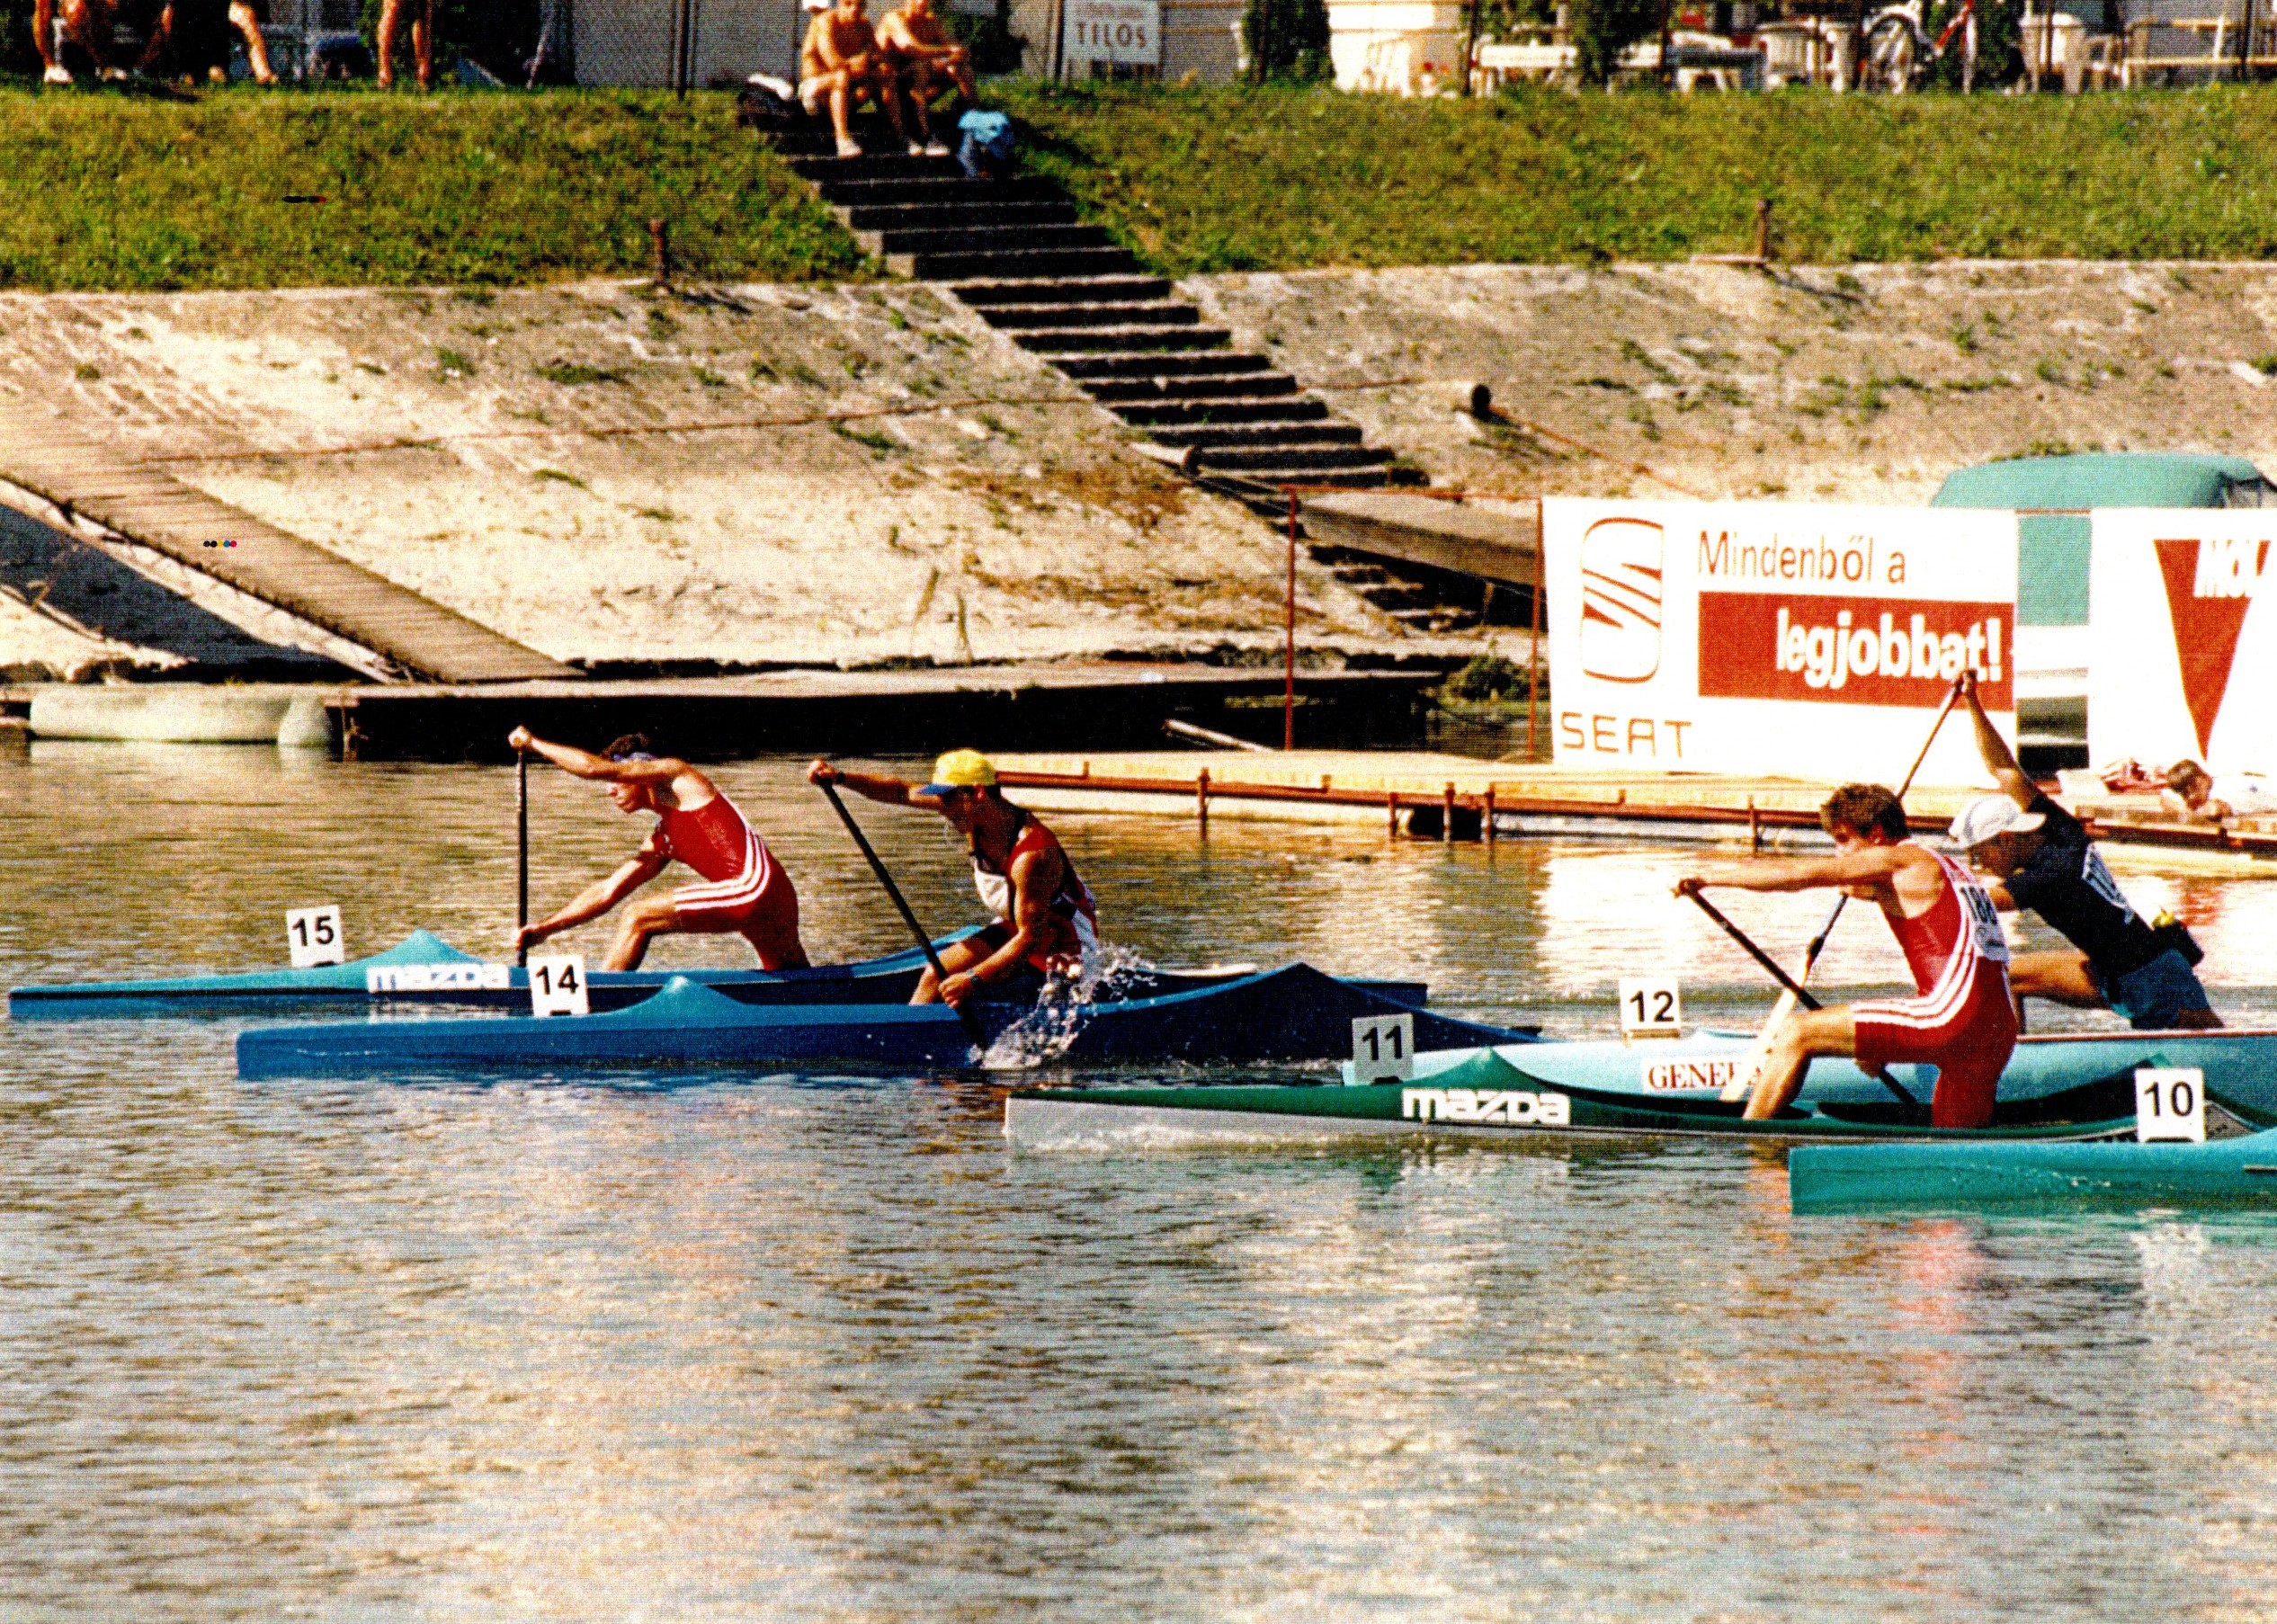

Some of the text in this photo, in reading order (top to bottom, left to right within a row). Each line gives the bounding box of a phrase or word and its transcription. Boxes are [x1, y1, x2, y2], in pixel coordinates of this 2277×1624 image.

[1076, 21, 1147, 49] TILOS
[1697, 530, 1906, 584] Mindenből a
[1775, 606, 2002, 689] legjobbat!
[1561, 711, 1692, 758] SEAT
[291, 915, 335, 947] 15
[535, 964, 580, 995] 14
[1630, 990, 1674, 1022] 12
[1362, 1025, 1404, 1061] 11
[2144, 1081, 2194, 1117] 10
